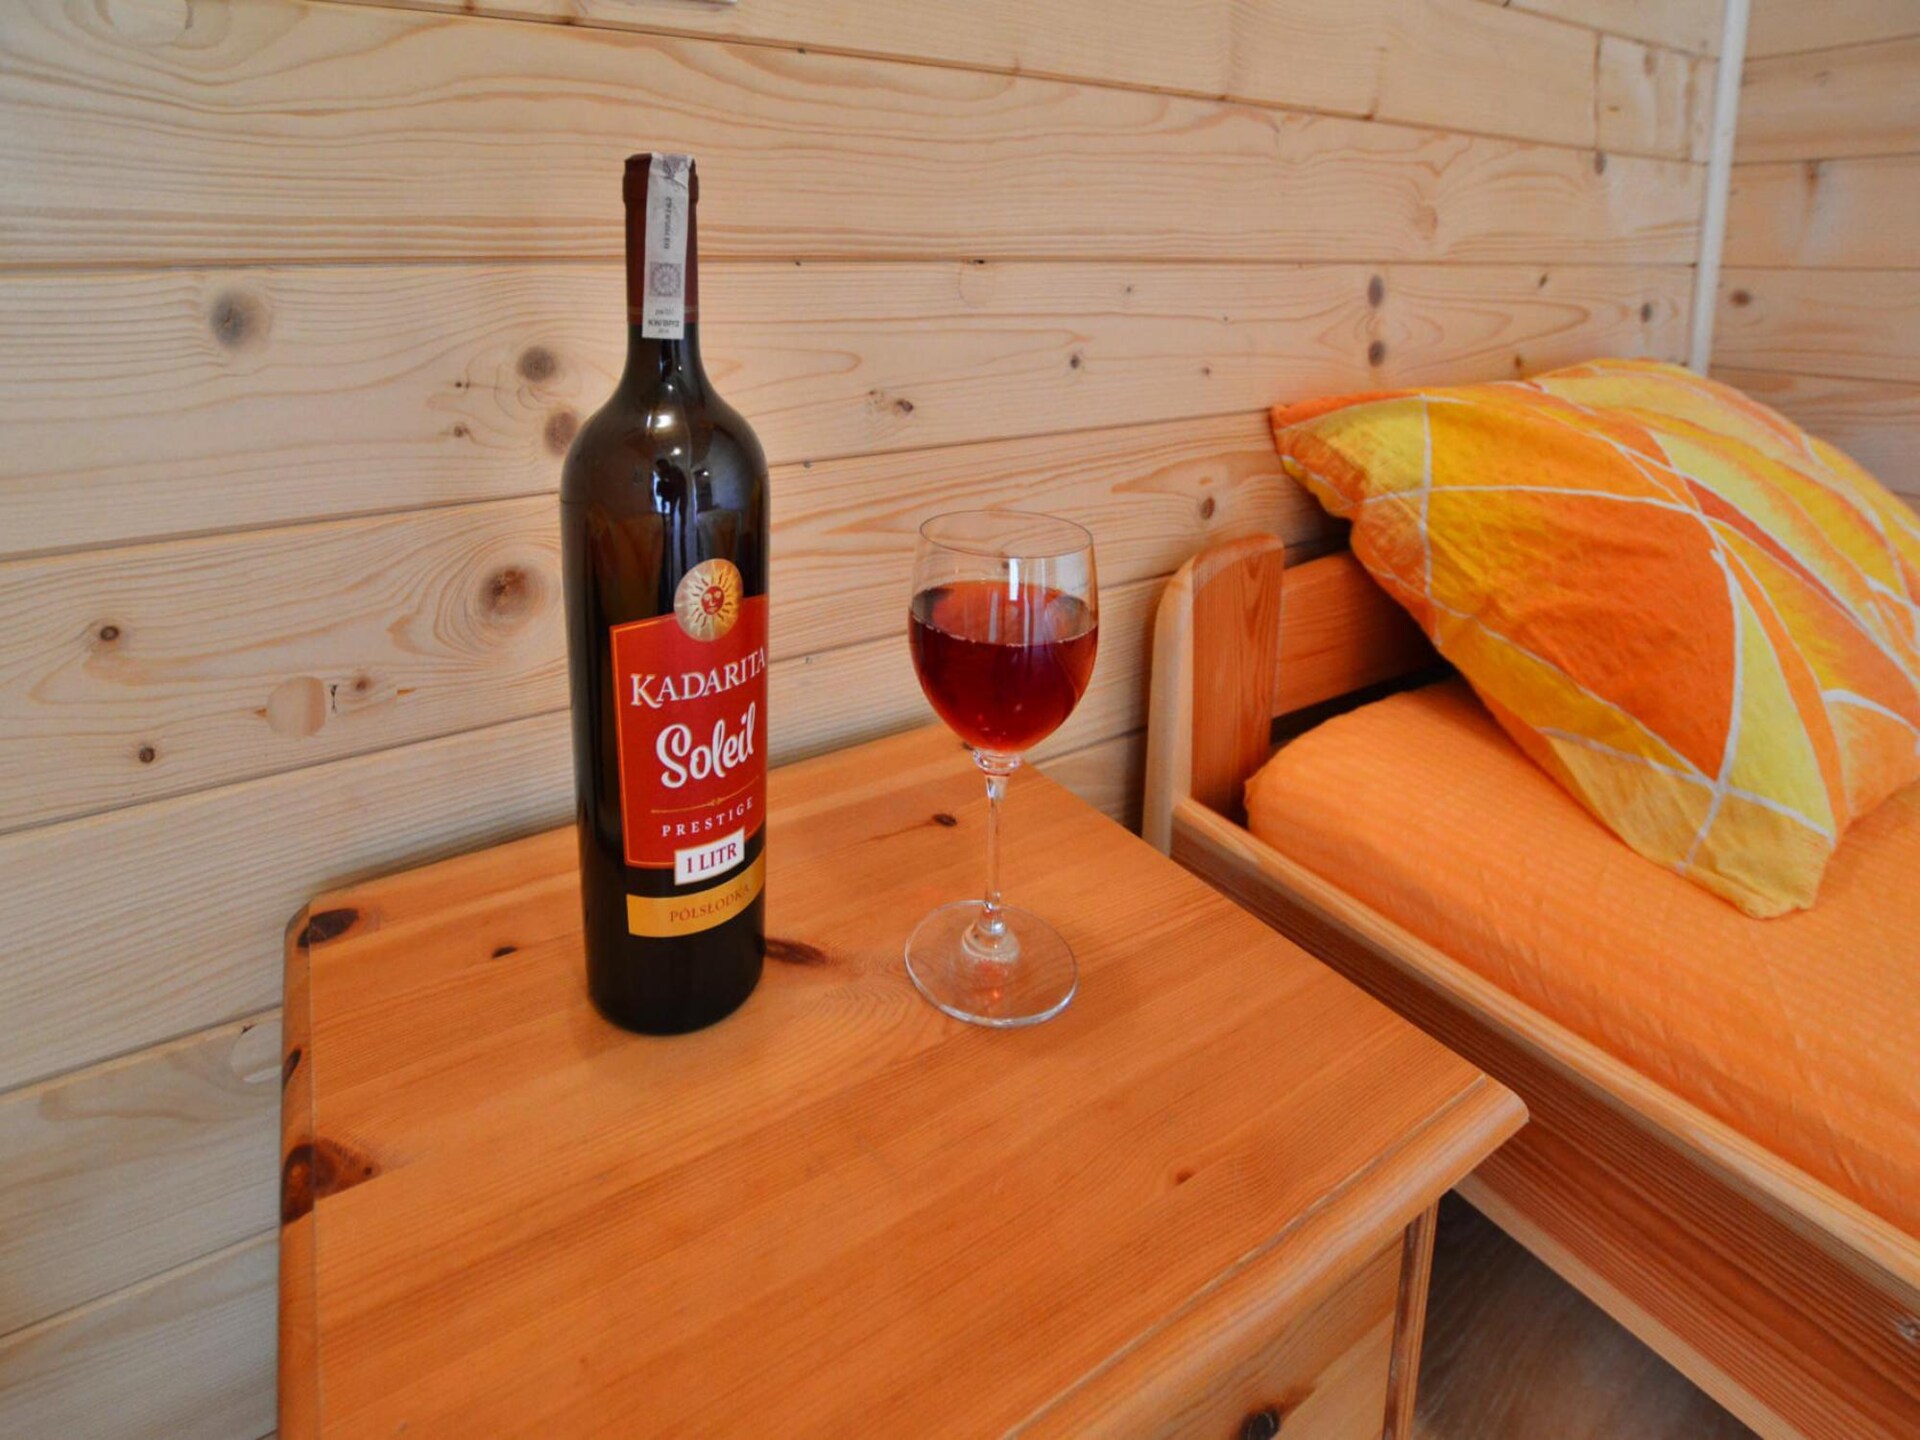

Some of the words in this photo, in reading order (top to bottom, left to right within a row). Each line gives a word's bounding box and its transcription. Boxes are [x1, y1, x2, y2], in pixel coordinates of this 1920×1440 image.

[630, 646, 766, 709] KADARITA
[656, 702, 755, 788] Soleil
[661, 800, 753, 837] PRESTIGE
[686, 857, 694, 874] 1
[698, 842, 738, 872] LITR
